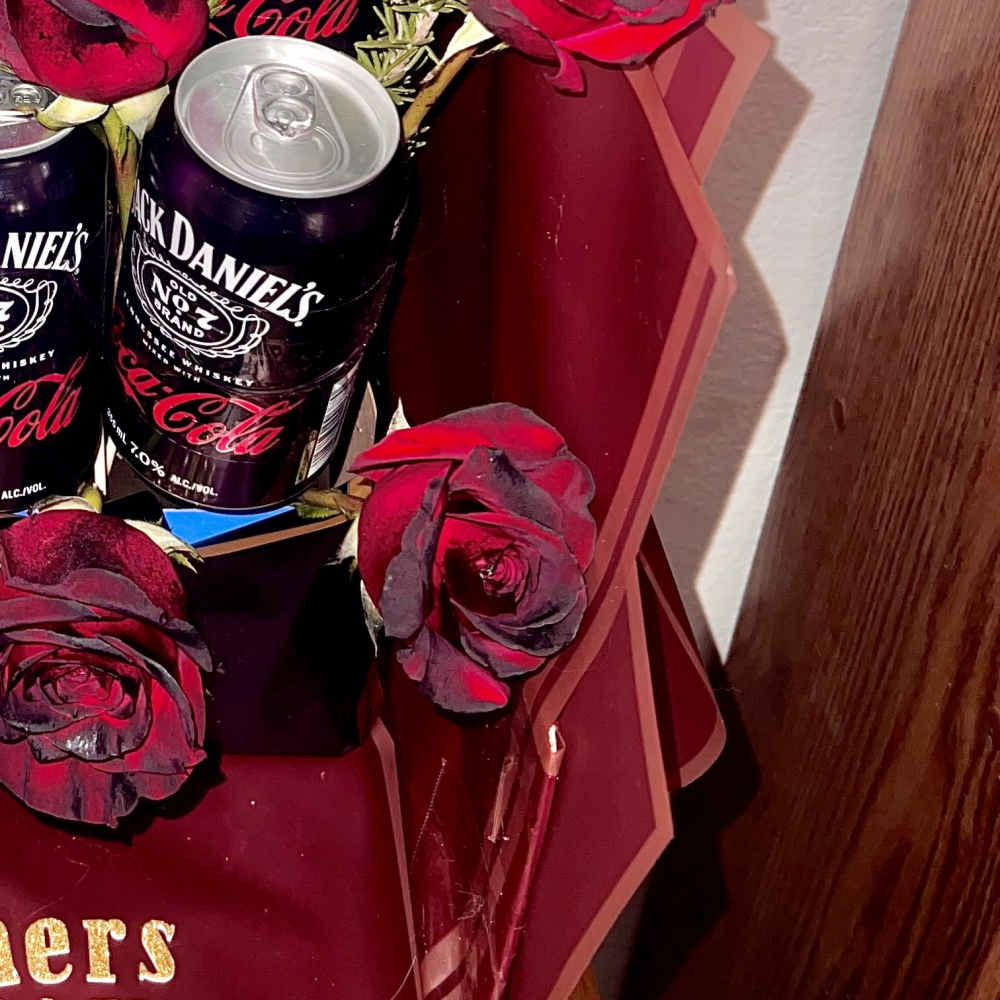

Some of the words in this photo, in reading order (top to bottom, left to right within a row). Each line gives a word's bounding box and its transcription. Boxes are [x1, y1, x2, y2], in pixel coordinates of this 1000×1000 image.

[131, 179, 167, 249] ACK
[168, 210, 325, 327] DANIEL'S
[169, 279, 198, 302] OLD
[154, 298, 205, 338] BRAND
[173, 364, 201, 383] WITH
[181, 358, 255, 387] WHISKEY
